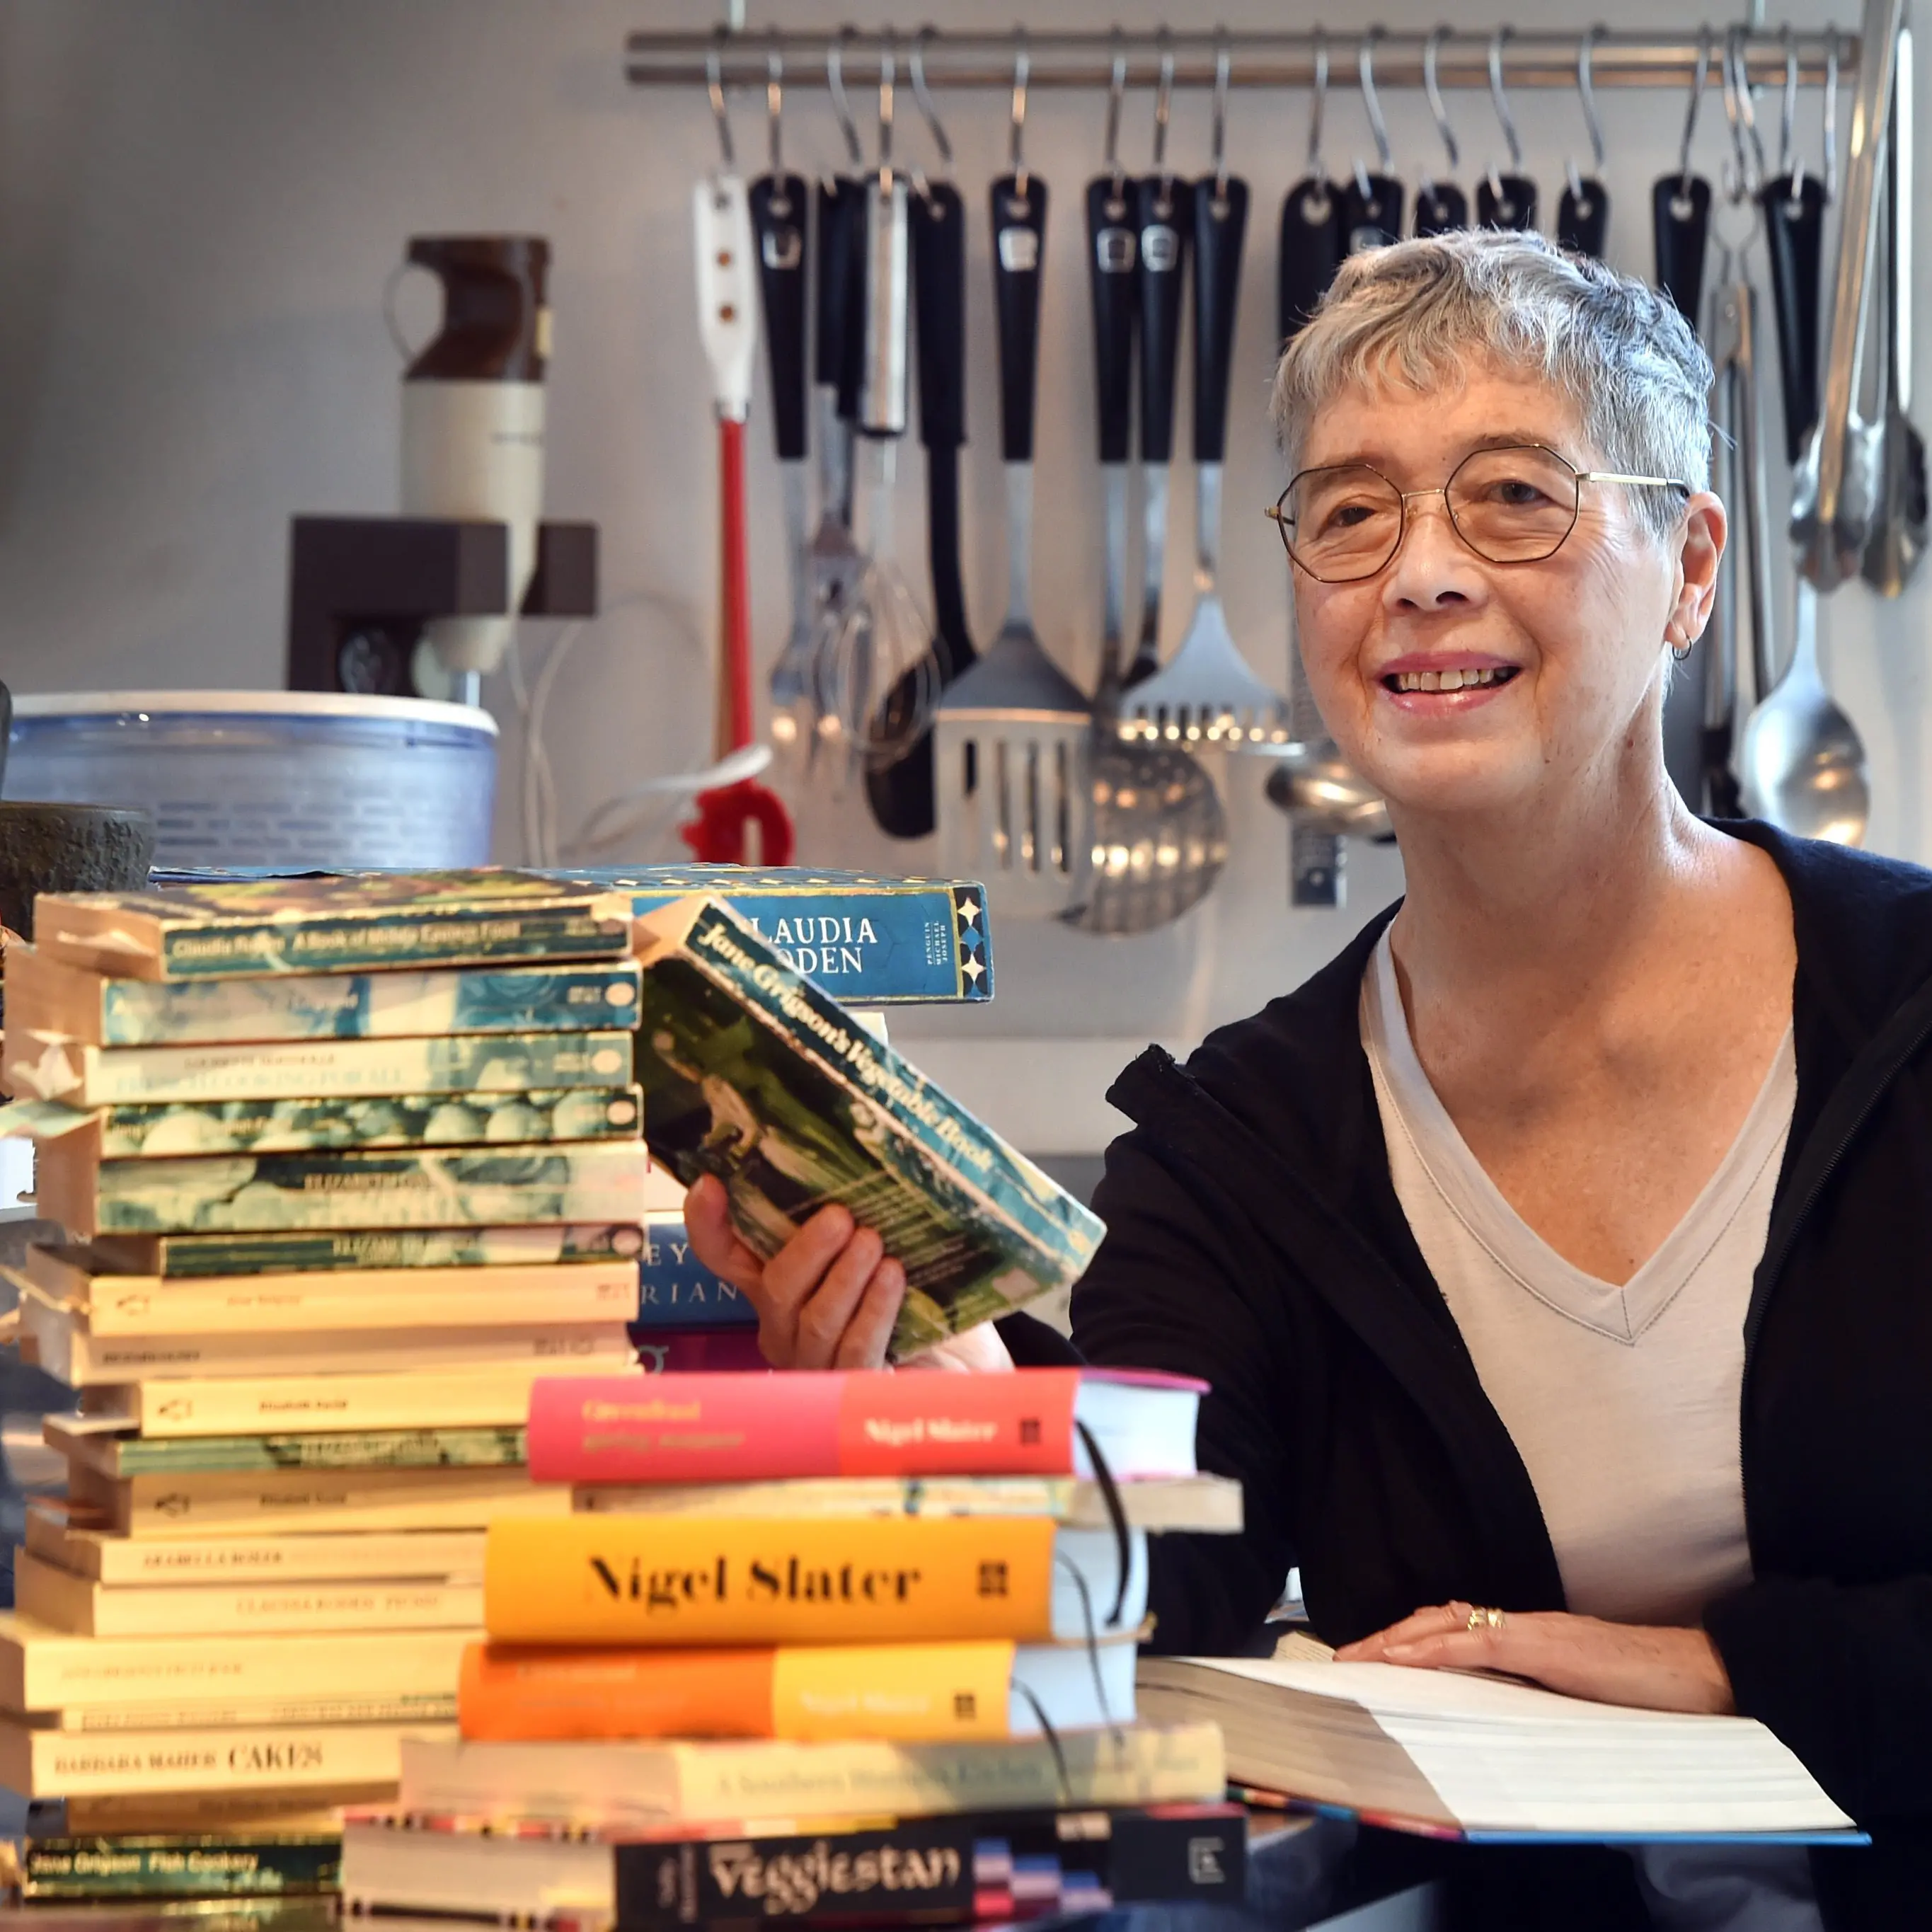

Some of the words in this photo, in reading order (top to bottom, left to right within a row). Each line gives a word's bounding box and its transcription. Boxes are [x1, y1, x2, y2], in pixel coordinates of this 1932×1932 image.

[751, 917, 878, 943] LAUDIA
[924, 922, 933, 965] PENGUIN
[778, 948, 863, 974] ODEN
[697, 923, 756, 970] Jane
[752, 964, 851, 1054] Grigson's
[846, 1039, 940, 1127] Vegetable
[934, 1116, 991, 1171] Book
[641, 1282, 737, 1304] RIAN
[590, 1555, 726, 1616] Nigel
[748, 1555, 923, 1602] Slater
[709, 1839, 960, 1914] Veggiestan
